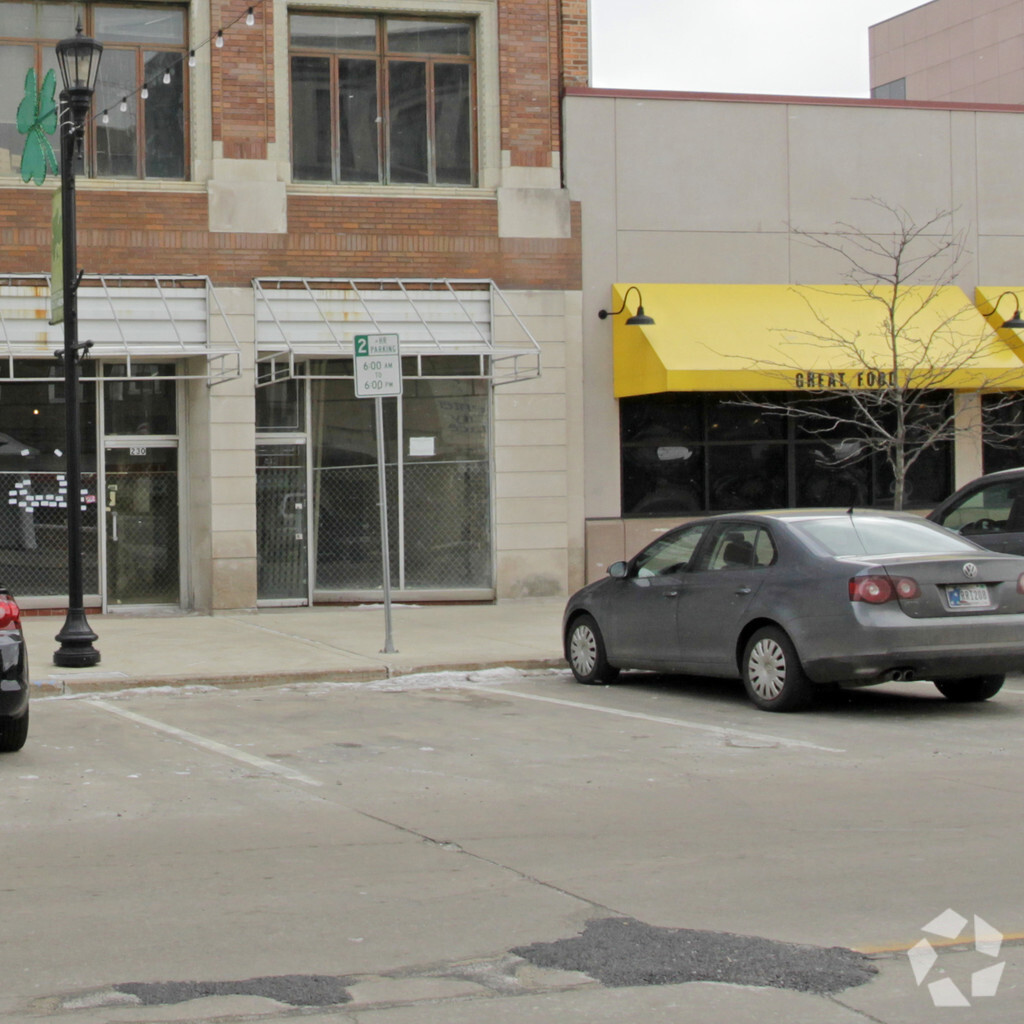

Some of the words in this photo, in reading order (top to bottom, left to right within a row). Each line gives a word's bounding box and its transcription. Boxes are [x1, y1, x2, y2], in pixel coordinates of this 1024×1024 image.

[357, 338, 367, 354] 2
[370, 345, 397, 353] PARKING
[363, 361, 382, 370] 6:00
[795, 372, 846, 388] GREAT
[364, 380, 383, 390] 6:00
[131, 447, 146, 455] 230
